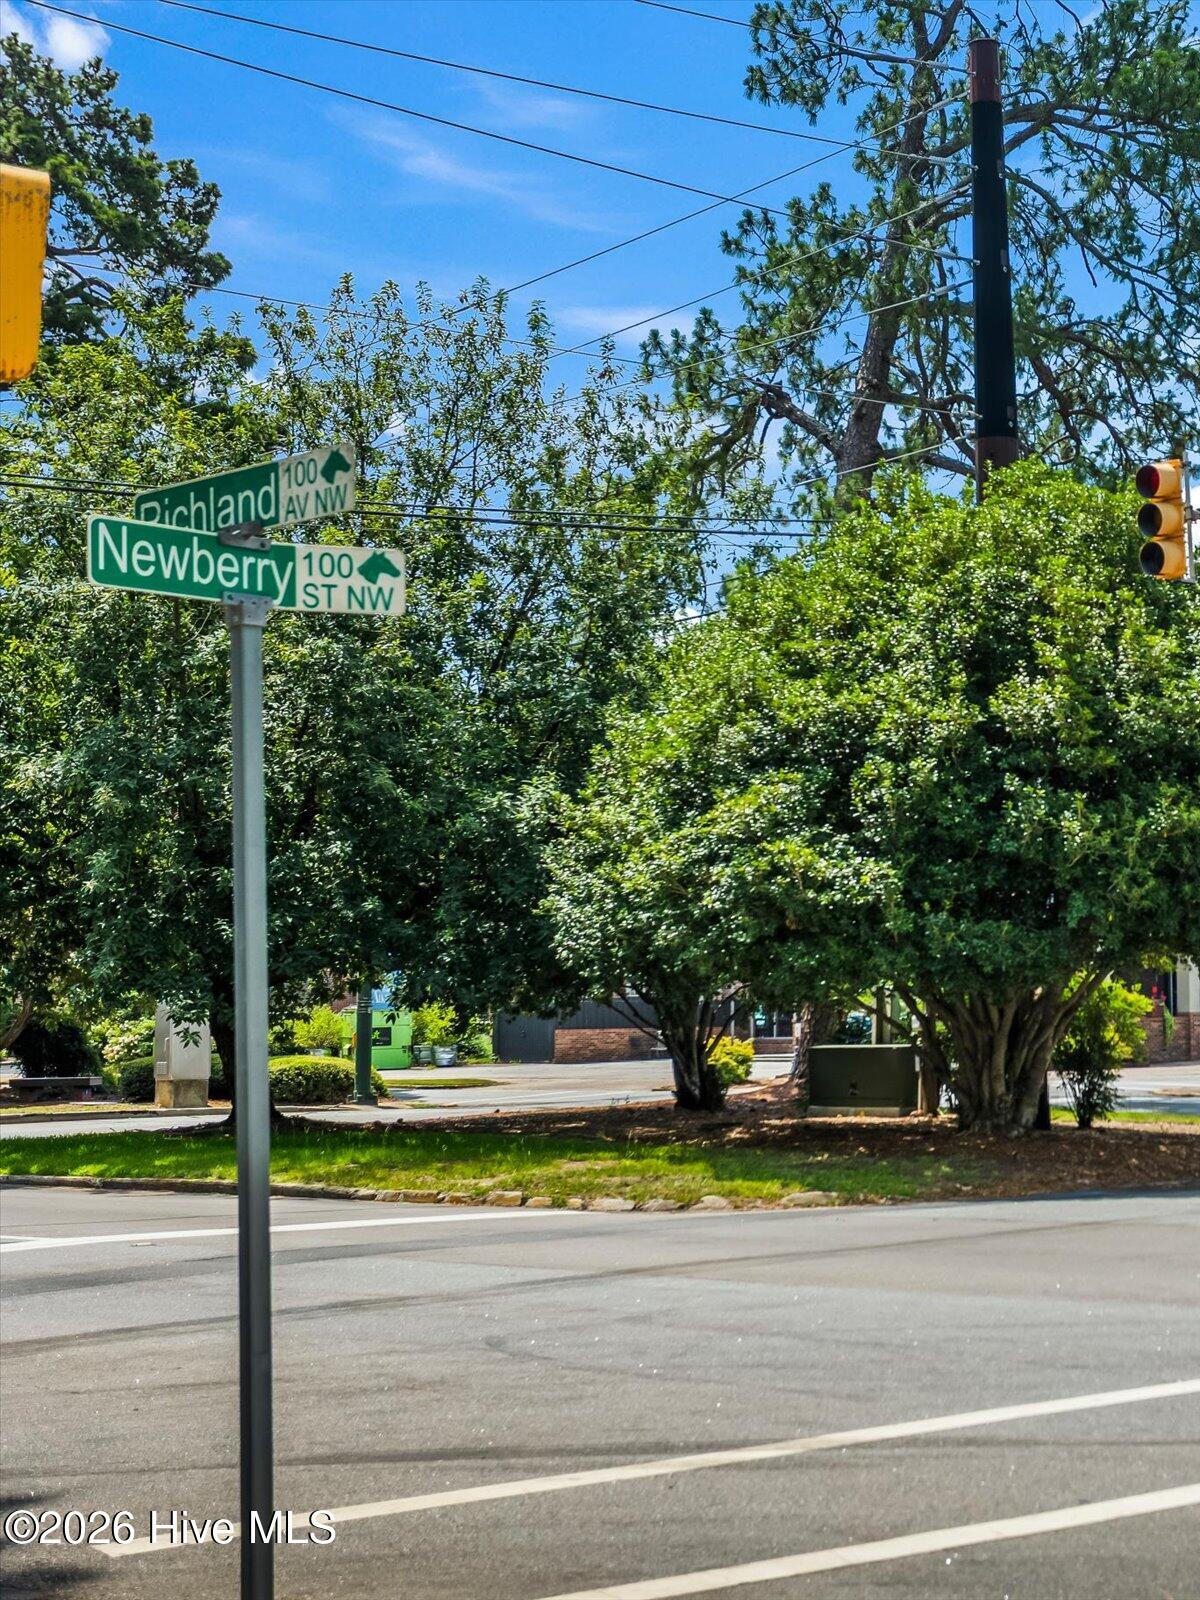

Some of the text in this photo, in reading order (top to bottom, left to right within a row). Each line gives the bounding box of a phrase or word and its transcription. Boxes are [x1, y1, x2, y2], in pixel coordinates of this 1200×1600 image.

[284, 458, 317, 489] 100
[284, 484, 347, 523] AV NW
[98, 522, 294, 606] Newberry
[303, 552, 353, 579] 100
[302, 582, 394, 611] ST NW
